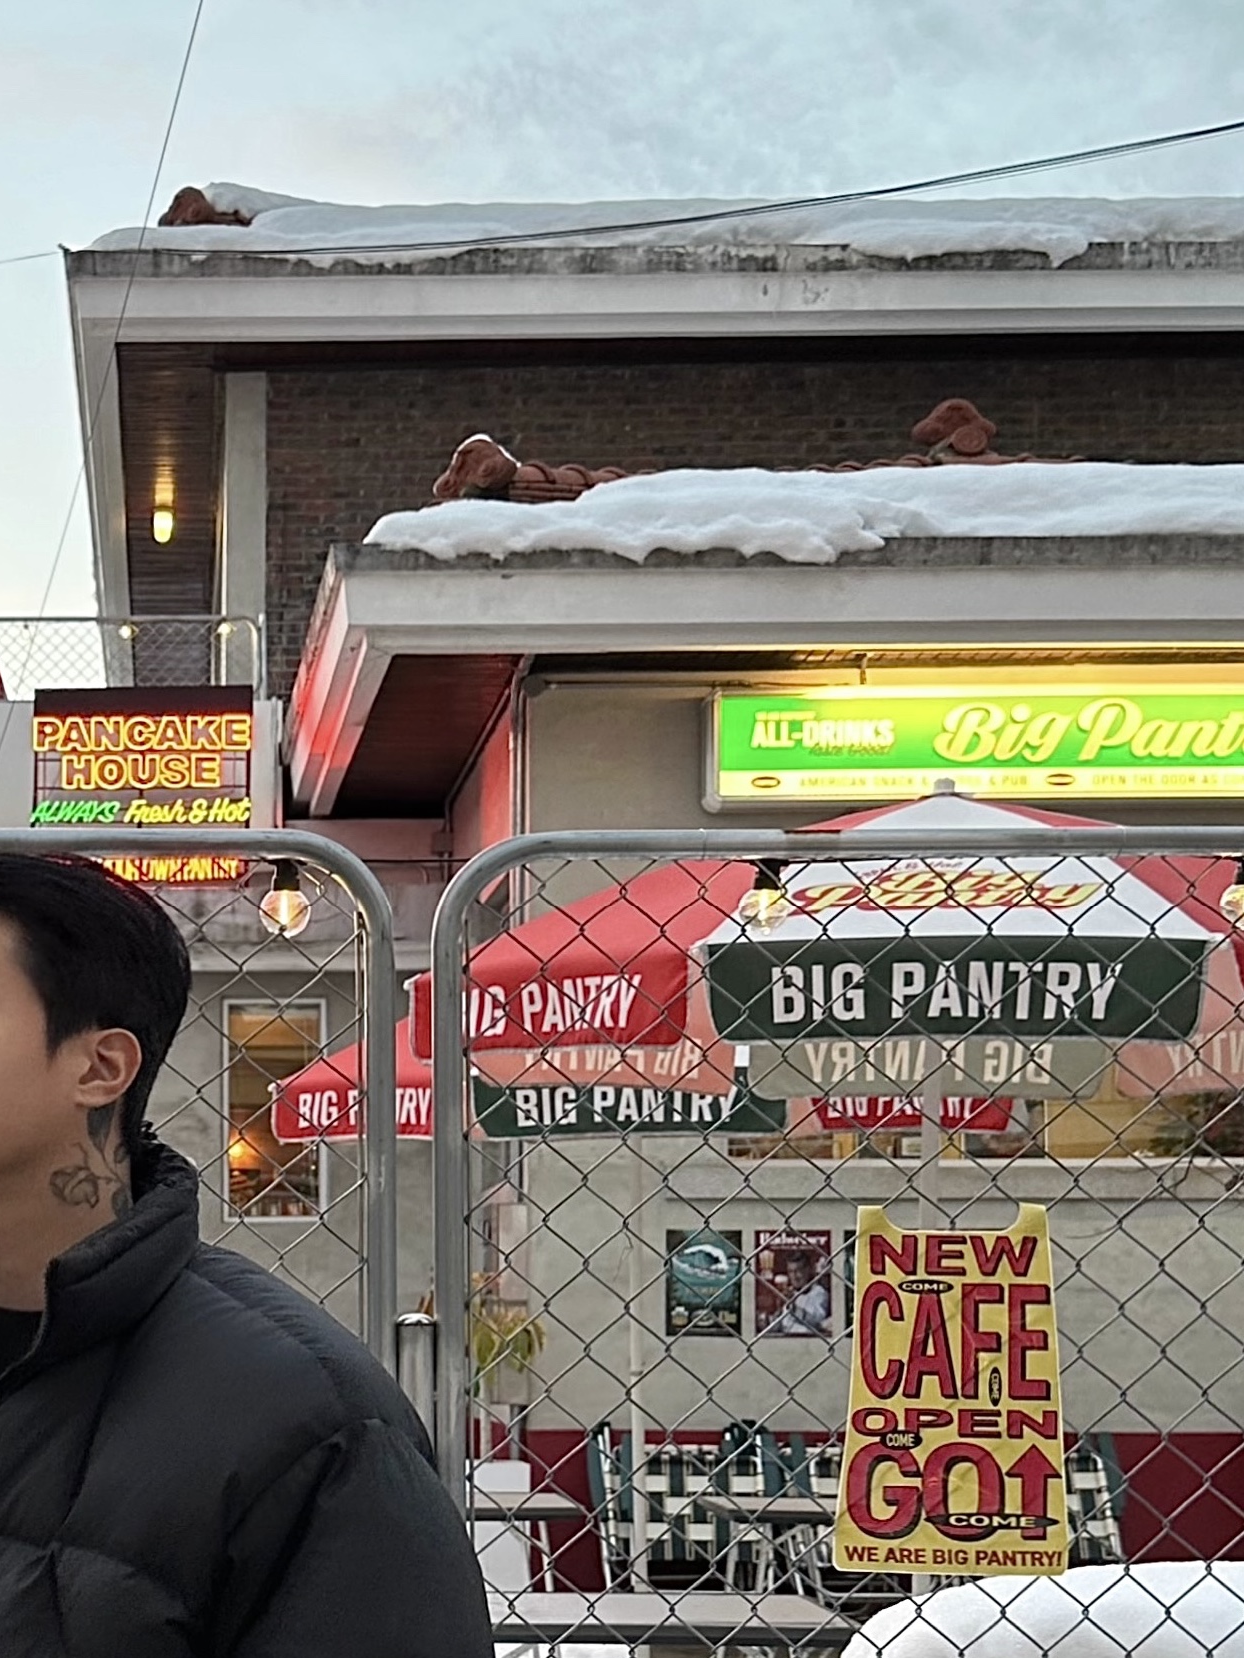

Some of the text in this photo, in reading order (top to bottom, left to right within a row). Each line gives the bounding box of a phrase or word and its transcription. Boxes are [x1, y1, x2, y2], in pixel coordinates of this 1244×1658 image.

[33, 715, 251, 751] PANCAKE
[751, 718, 896, 749] ALL-DRINKS
[933, 697, 1244, 763] Big Pant
[62, 754, 220, 790] HOUSE
[30, 797, 251, 824] ALWAYS Fresh & Hot
[462, 974, 642, 1038] IG PANTRY
[771, 961, 1122, 1024] BIG PANTRY
[297, 1088, 339, 1130] BIG
[516, 1084, 738, 1128] BIG PANTRY
[868, 1234, 1038, 1276] NEW
[902, 1281, 949, 1292] COME
[859, 1280, 1051, 1401] CAFE
[851, 1407, 1058, 1439] OPEN
[885, 1433, 915, 1448] COME
[846, 1441, 1005, 1542] GO
[949, 1514, 1036, 1528] COME
[844, 1545, 1063, 1567] WE ARE BIG PANTRY!
